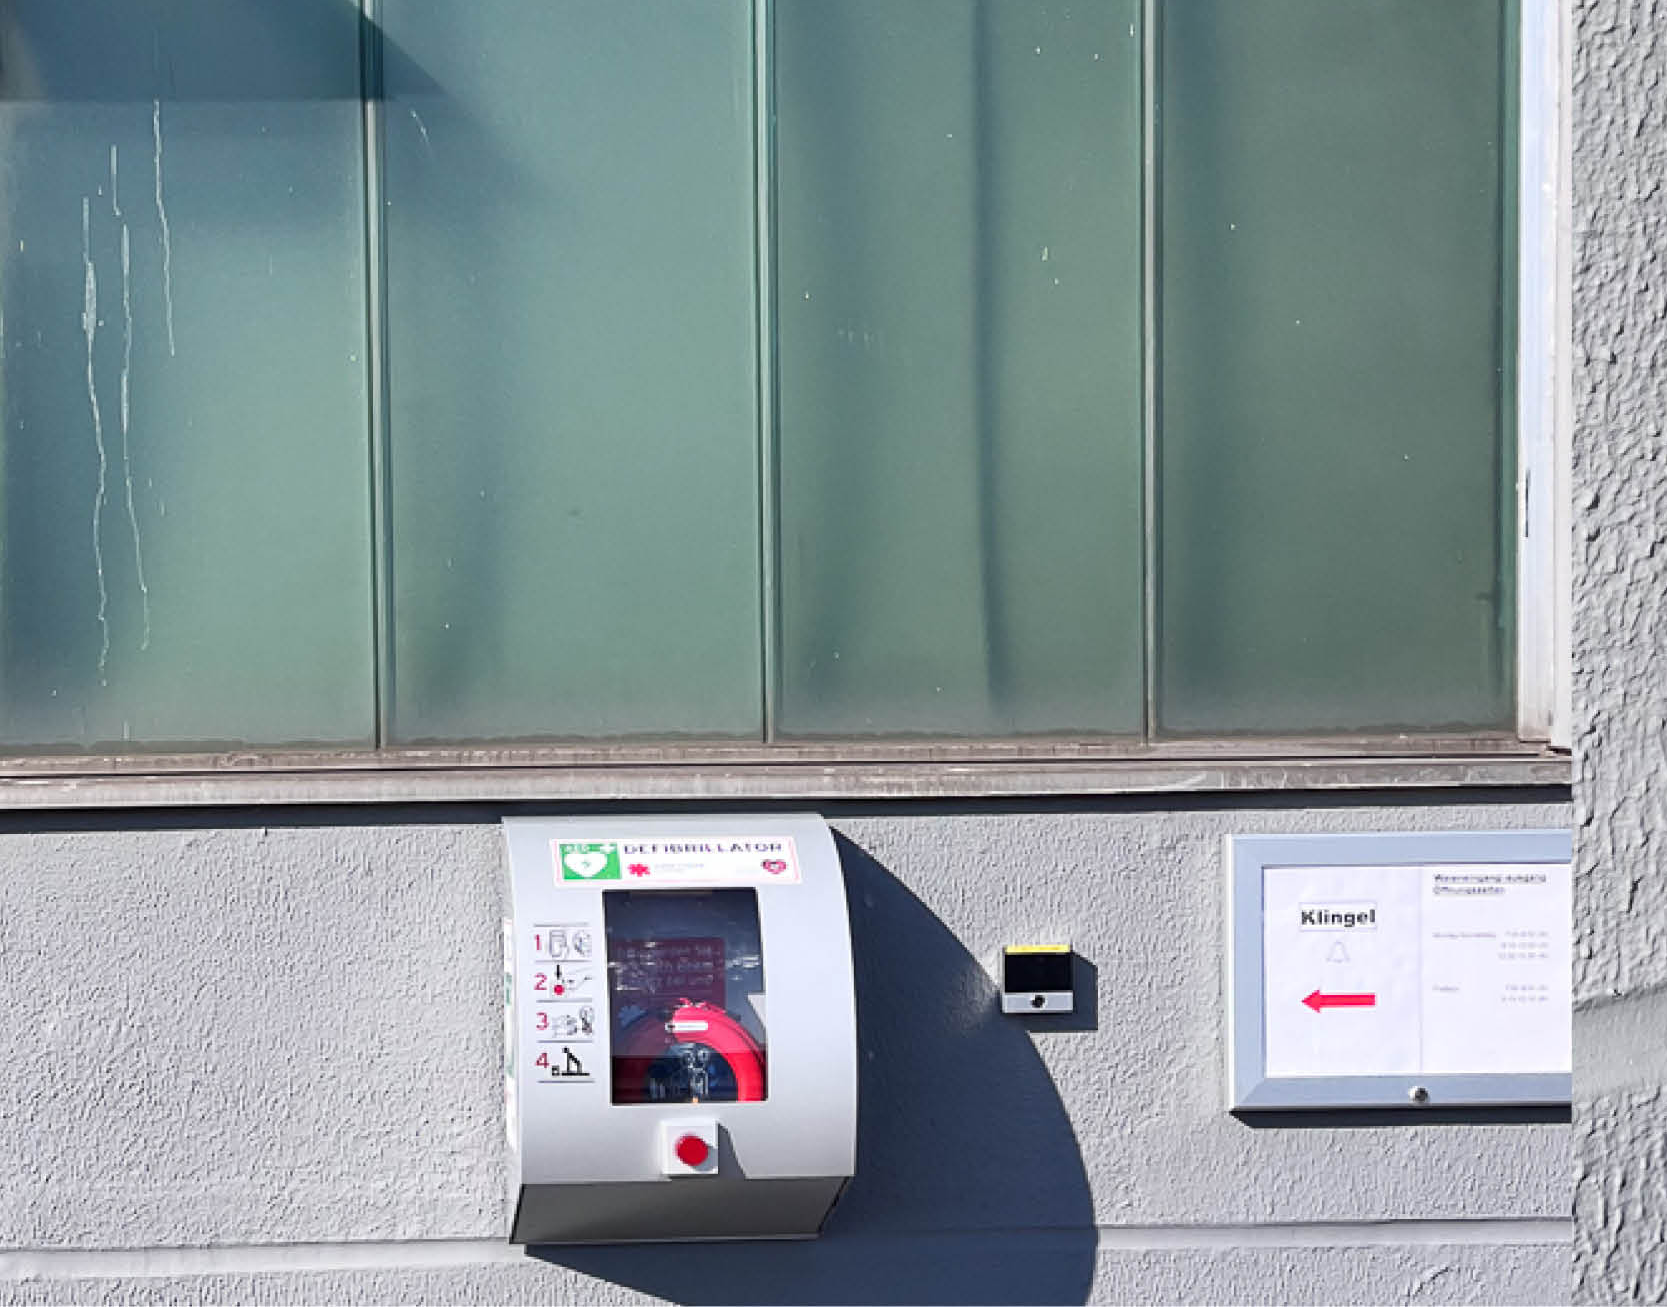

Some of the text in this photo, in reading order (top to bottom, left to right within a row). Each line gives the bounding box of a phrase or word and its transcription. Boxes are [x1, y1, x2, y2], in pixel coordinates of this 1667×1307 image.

[1301, 908, 1376, 928] Klingel
[534, 934, 542, 951] 1
[534, 972, 548, 991] 2
[536, 1012, 550, 1031] 3
[535, 1052, 550, 1068] 4
